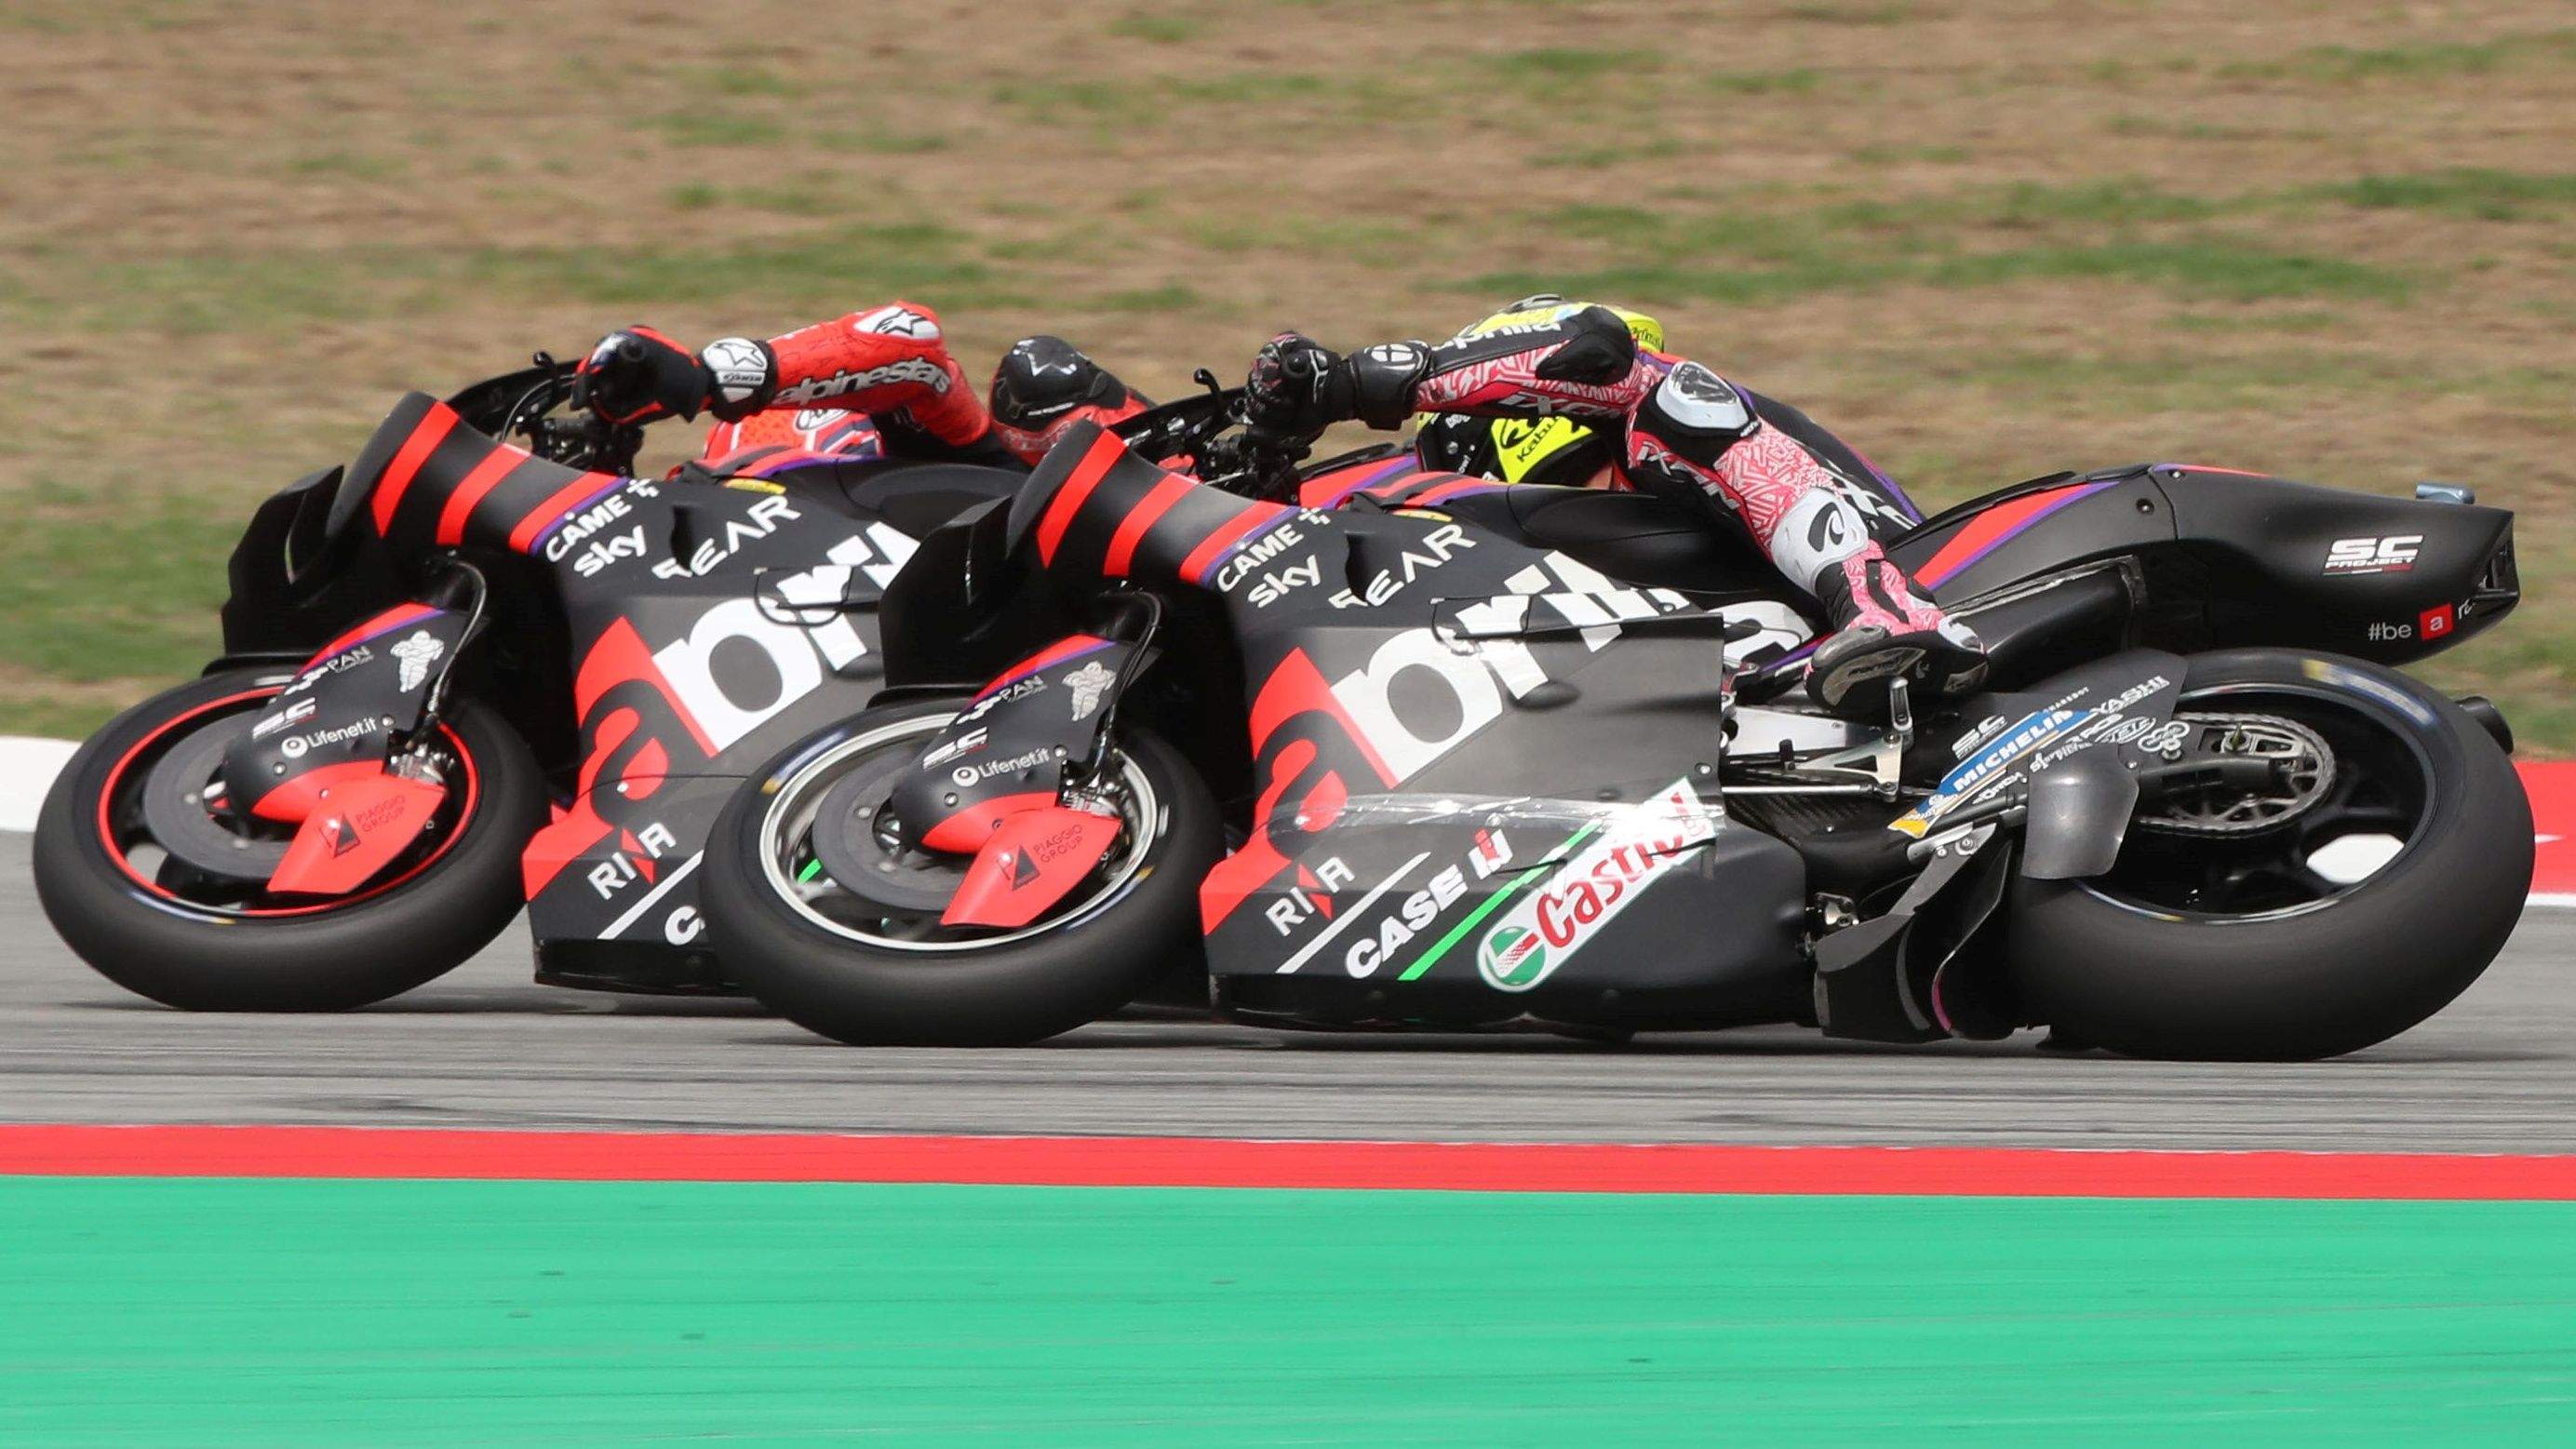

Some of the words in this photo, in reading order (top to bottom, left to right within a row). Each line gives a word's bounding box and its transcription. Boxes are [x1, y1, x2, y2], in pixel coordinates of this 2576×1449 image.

[771, 356, 950, 407] alpinestars
[545, 494, 633, 562] CAME
[1216, 523, 1305, 593] CAME
[2327, 534, 2424, 562] SC
[2368, 622, 2412, 641] #be
[2429, 615, 2445, 632] a
[305, 716, 378, 748] Lifenet.it
[977, 746, 1051, 778] Lifenet.it
[1952, 710, 2073, 792] MICHELIN
[1033, 824, 1083, 854] PIAGGIO
[1040, 835, 1083, 864] GROUP
[1345, 864, 1469, 979] CASE
